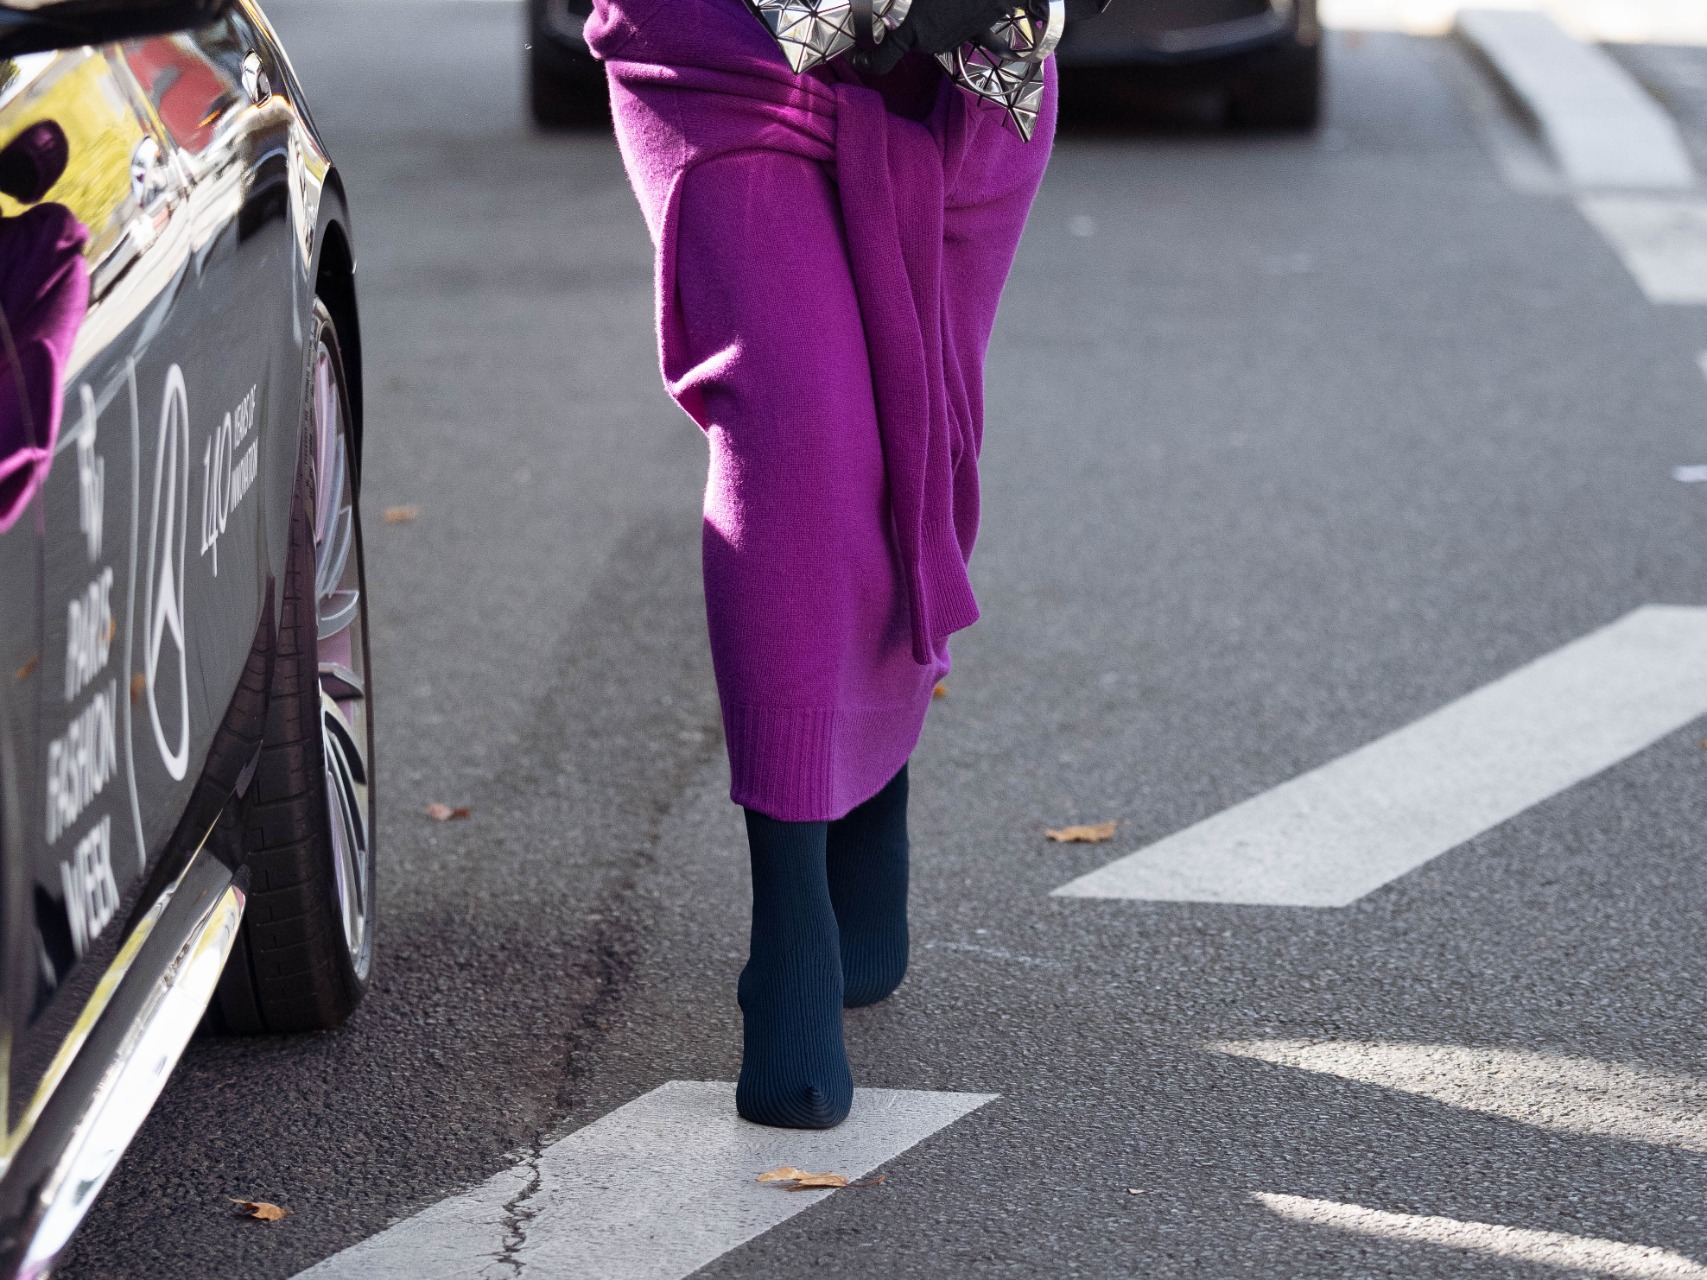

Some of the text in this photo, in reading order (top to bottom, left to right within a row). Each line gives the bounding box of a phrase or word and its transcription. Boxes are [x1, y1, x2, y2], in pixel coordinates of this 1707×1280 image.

[200, 412, 232, 577] 140
[64, 566, 113, 701] PARIS
[45, 678, 118, 845] FASHION
[60, 814, 120, 959] WEEK
